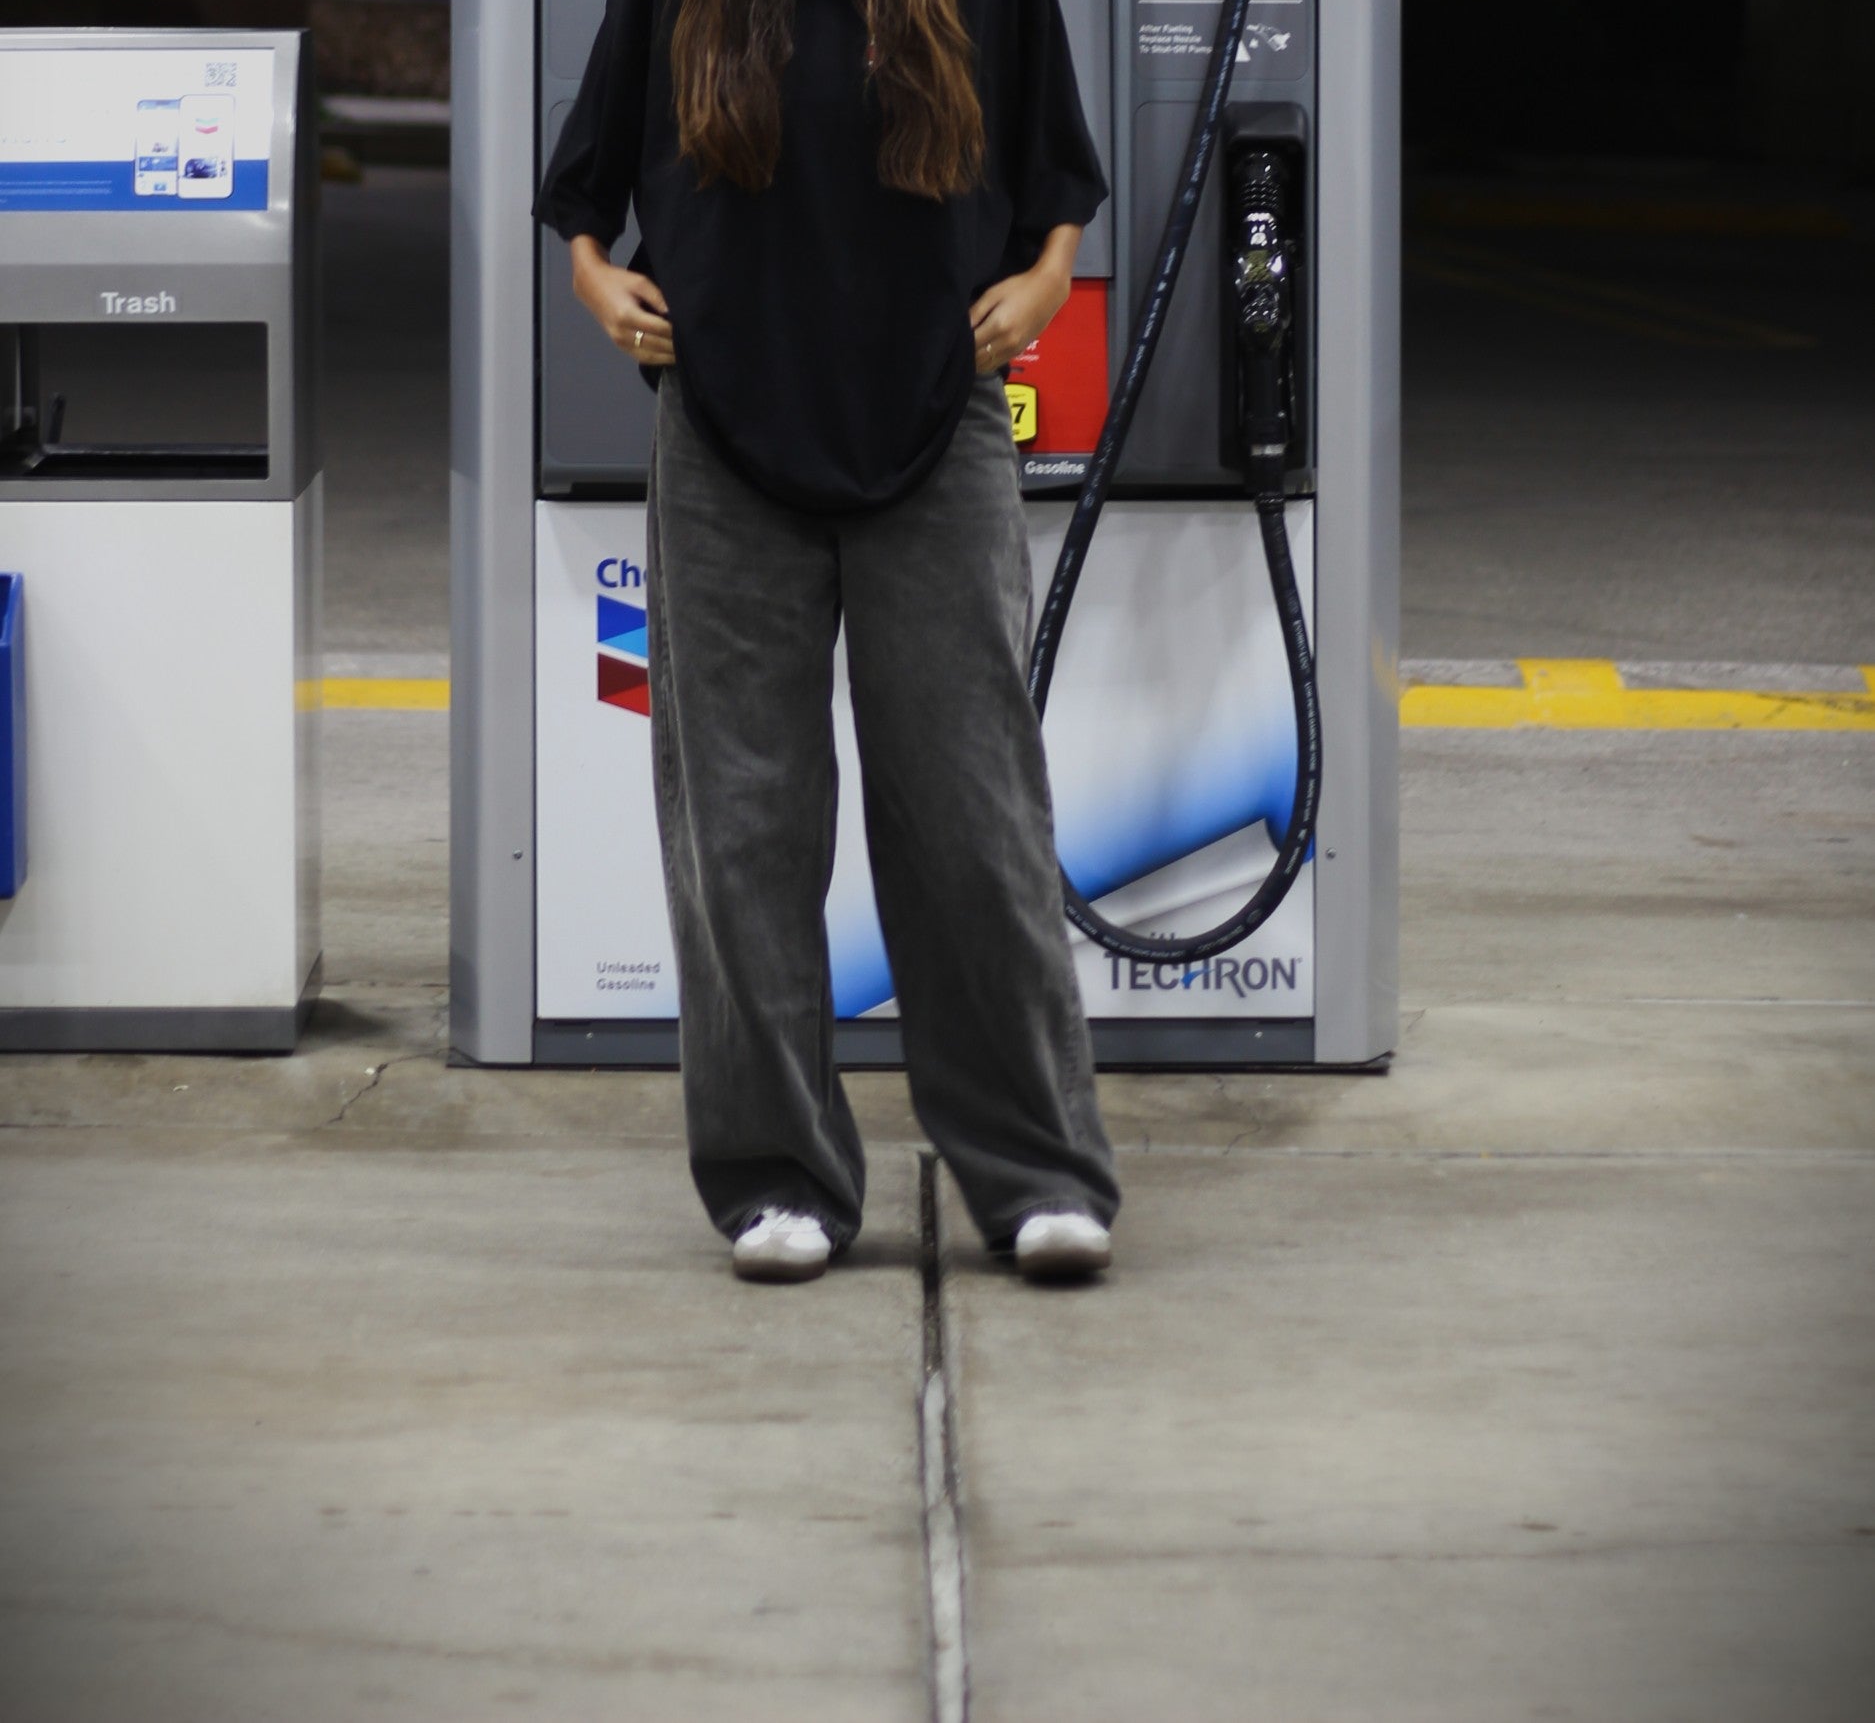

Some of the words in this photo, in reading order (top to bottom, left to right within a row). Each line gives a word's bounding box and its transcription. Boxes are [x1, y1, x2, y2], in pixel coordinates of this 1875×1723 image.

[1139, 24, 1162, 33] After
[1162, 24, 1194, 35] Fueling
[1173, 34, 1202, 44] Nozzle
[101, 291, 176, 315] Trash
[1011, 403, 1027, 424] 7
[1024, 460, 1086, 475] Gasoline
[596, 961, 661, 974] Unleaded
[1103, 951, 1297, 998] TECHRON
[596, 977, 656, 990] Gasoline
